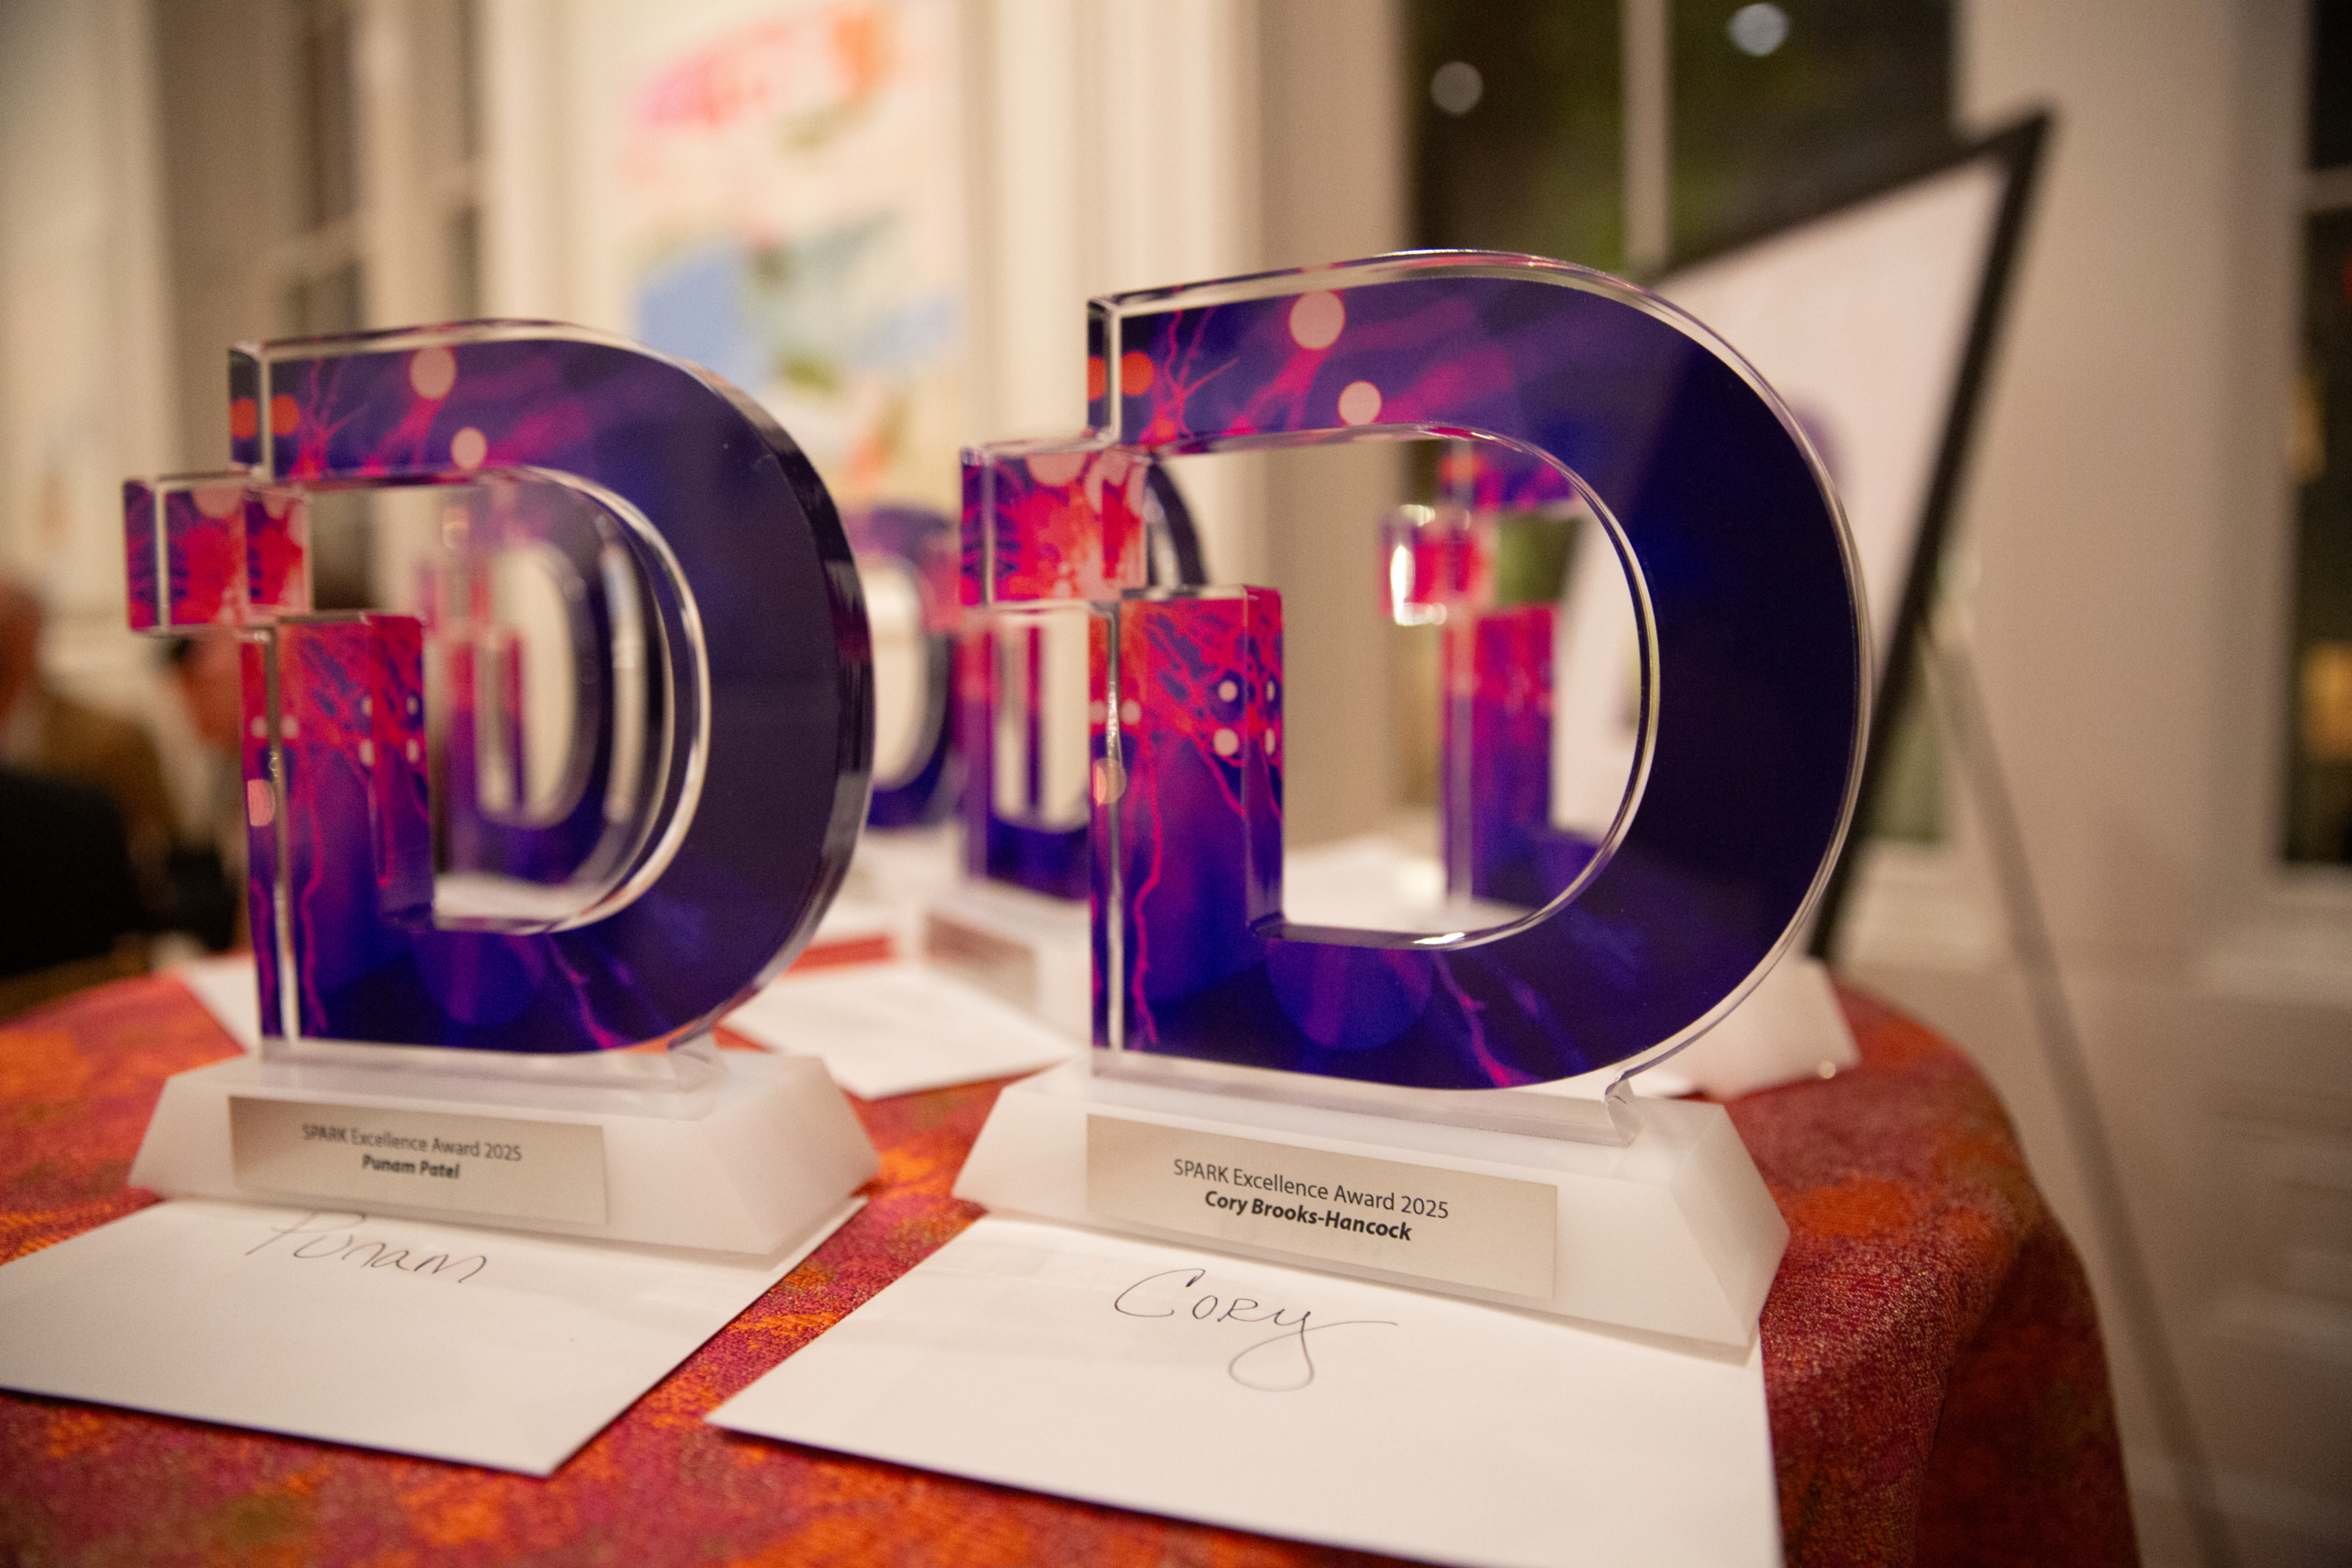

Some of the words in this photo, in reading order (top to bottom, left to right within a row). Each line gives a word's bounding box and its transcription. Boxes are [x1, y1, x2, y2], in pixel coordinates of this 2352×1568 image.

[302, 1122, 346, 1143] SPARK
[351, 1127, 427, 1152] Excellence
[432, 1137, 481, 1157] Award
[484, 1142, 523, 1162] 2025
[362, 1154, 416, 1175] Punam
[420, 1159, 460, 1179] Patel
[1173, 1158, 1229, 1184] SPARK
[1234, 1168, 1329, 1201] Excellence
[1333, 1184, 1395, 1212] Award
[1400, 1195, 1449, 1219] 2025
[1204, 1190, 1249, 1216] Cory
[1251, 1198, 1413, 1241] Brooks-Hancock
